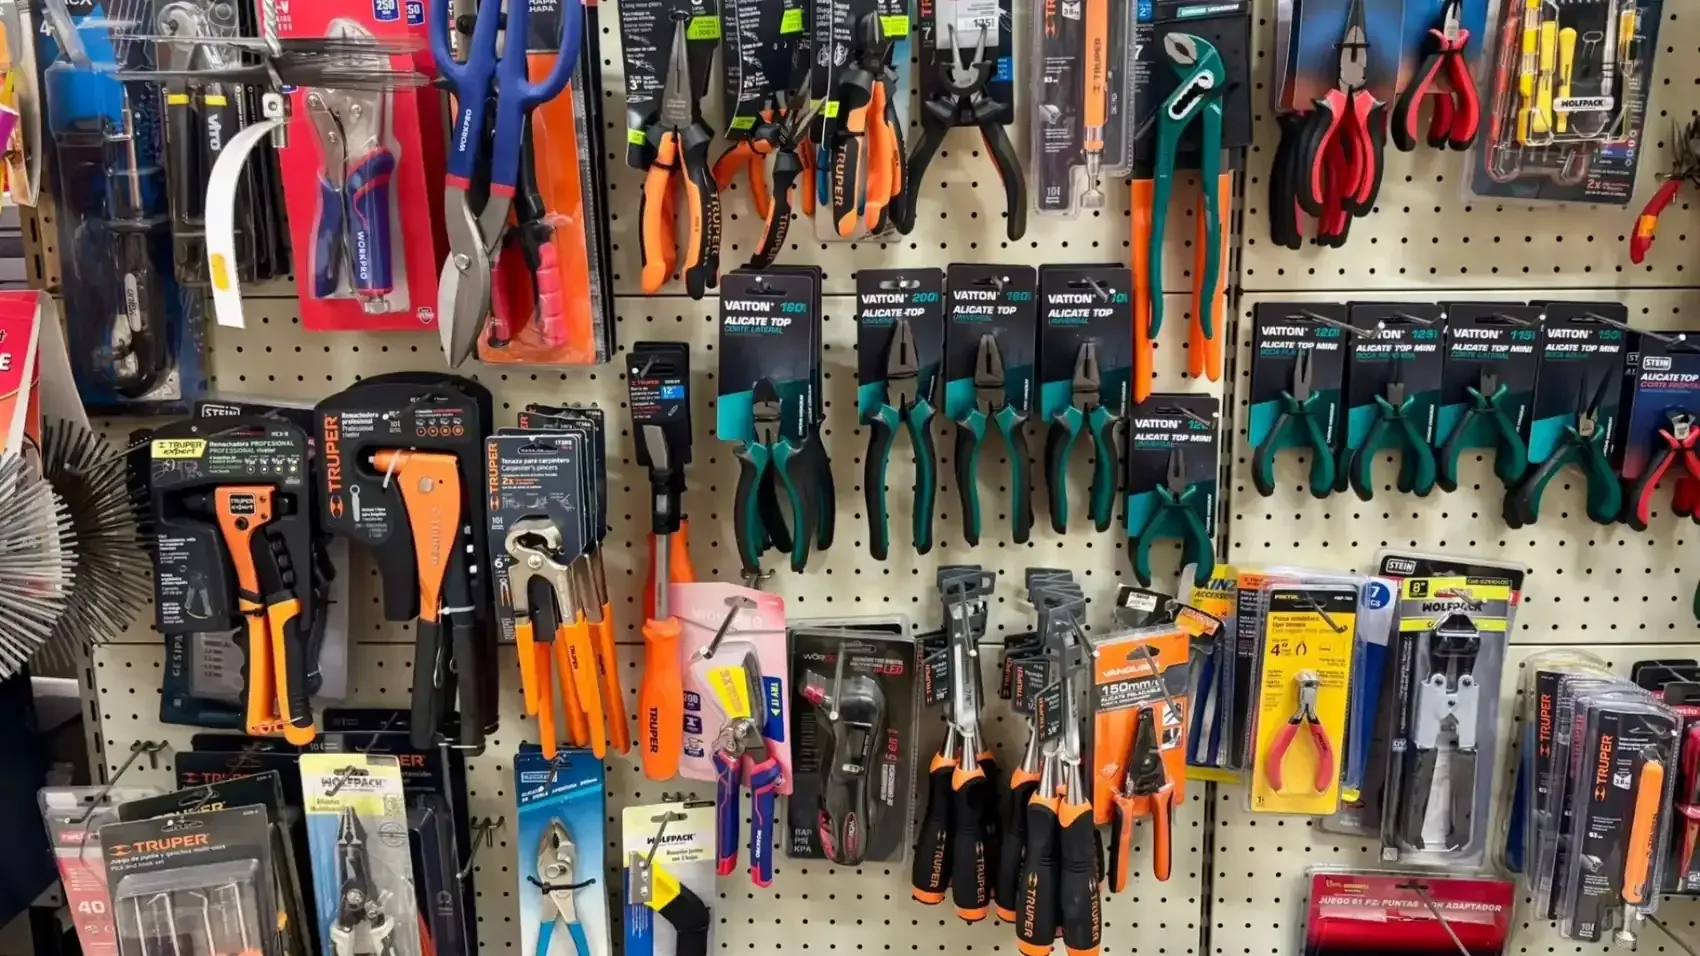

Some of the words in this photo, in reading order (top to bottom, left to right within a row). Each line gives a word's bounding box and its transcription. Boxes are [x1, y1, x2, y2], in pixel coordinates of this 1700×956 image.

[405, 4, 420, 14] 50
[1561, 99, 1604, 108] WOLFPACK
[459, 108, 472, 152] WORKPRO
[834, 144, 847, 207] TRUPER
[711, 191, 721, 256] TRUPER
[357, 231, 368, 280] WORKPRO
[862, 294, 906, 305] VATTON
[953, 291, 998, 302] VATTON
[1048, 293, 1093, 304] VATTON
[724, 301, 771, 312] VATTON
[953, 305, 994, 315] ALICATE
[997, 306, 1017, 315] TOP
[862, 308, 903, 318] ALICATE
[1048, 308, 1090, 318] ALICATE
[1093, 309, 1113, 318] TOP
[724, 316, 768, 327] ALICATE
[771, 317, 792, 327] TOP
[1261, 326, 1306, 338] VATTON
[1453, 329, 1500, 340] VATTON
[1547, 329, 1589, 340] VATTON
[1260, 341, 1295, 350] ALICATE
[1297, 341, 1314, 350] TOP
[1316, 342, 1339, 351] MINI
[1356, 344, 1392, 353] ALICATE
[1394, 344, 1412, 353] TOP
[1413, 344, 1436, 353] MINI
[1452, 343, 1489, 352] ALICATE
[1491, 344, 1509, 353] TOP
[1510, 344, 1533, 354] MINI
[1545, 343, 1580, 353] ALICATE
[1581, 344, 1598, 352] TOP
[1599, 345, 1620, 353] MINI
[1645, 359, 1670, 369] STEIN
[1641, 372, 1679, 382] ALICATE
[1680, 374, 1699, 382] TOP
[1135, 419, 1178, 429] VATTON
[1134, 433, 1170, 442] ALICATE
[1172, 434, 1189, 442] TOP
[1190, 434, 1212, 443] MINI
[168, 441, 202, 449] TRUPER
[324, 415, 343, 493] TRUPER
[488, 443, 499, 494] TRUPER
[1388, 562, 1413, 572] STEIN
[1371, 586, 1379, 598] 7
[1412, 582, 1427, 593] 8"
[1271, 642, 1288, 656] 4"
[172, 634, 184, 677] GESIPA
[884, 664, 904, 675] LED
[770, 682, 779, 696] TRY
[770, 697, 779, 707] IT
[1540, 694, 1551, 741] TRUPER
[649, 707, 658, 754] TRUPER
[1595, 735, 1613, 784] TRUPER
[320, 777, 383, 788] WOFPACK
[133, 833, 209, 853] TRUPER
[647, 833, 694, 844] WLFPACK
[929, 843, 946, 888] TRUPER
[976, 857, 986, 903] TRUPER
[78, 901, 106, 914] 40
[1319, 896, 1350, 905] JUEGO
[1382, 899, 1418, 907] PUNTAS
[1446, 903, 1502, 912] ADAPTADOR
[1024, 887, 1038, 938] TRUPER
[1090, 894, 1101, 943] TRUPER
